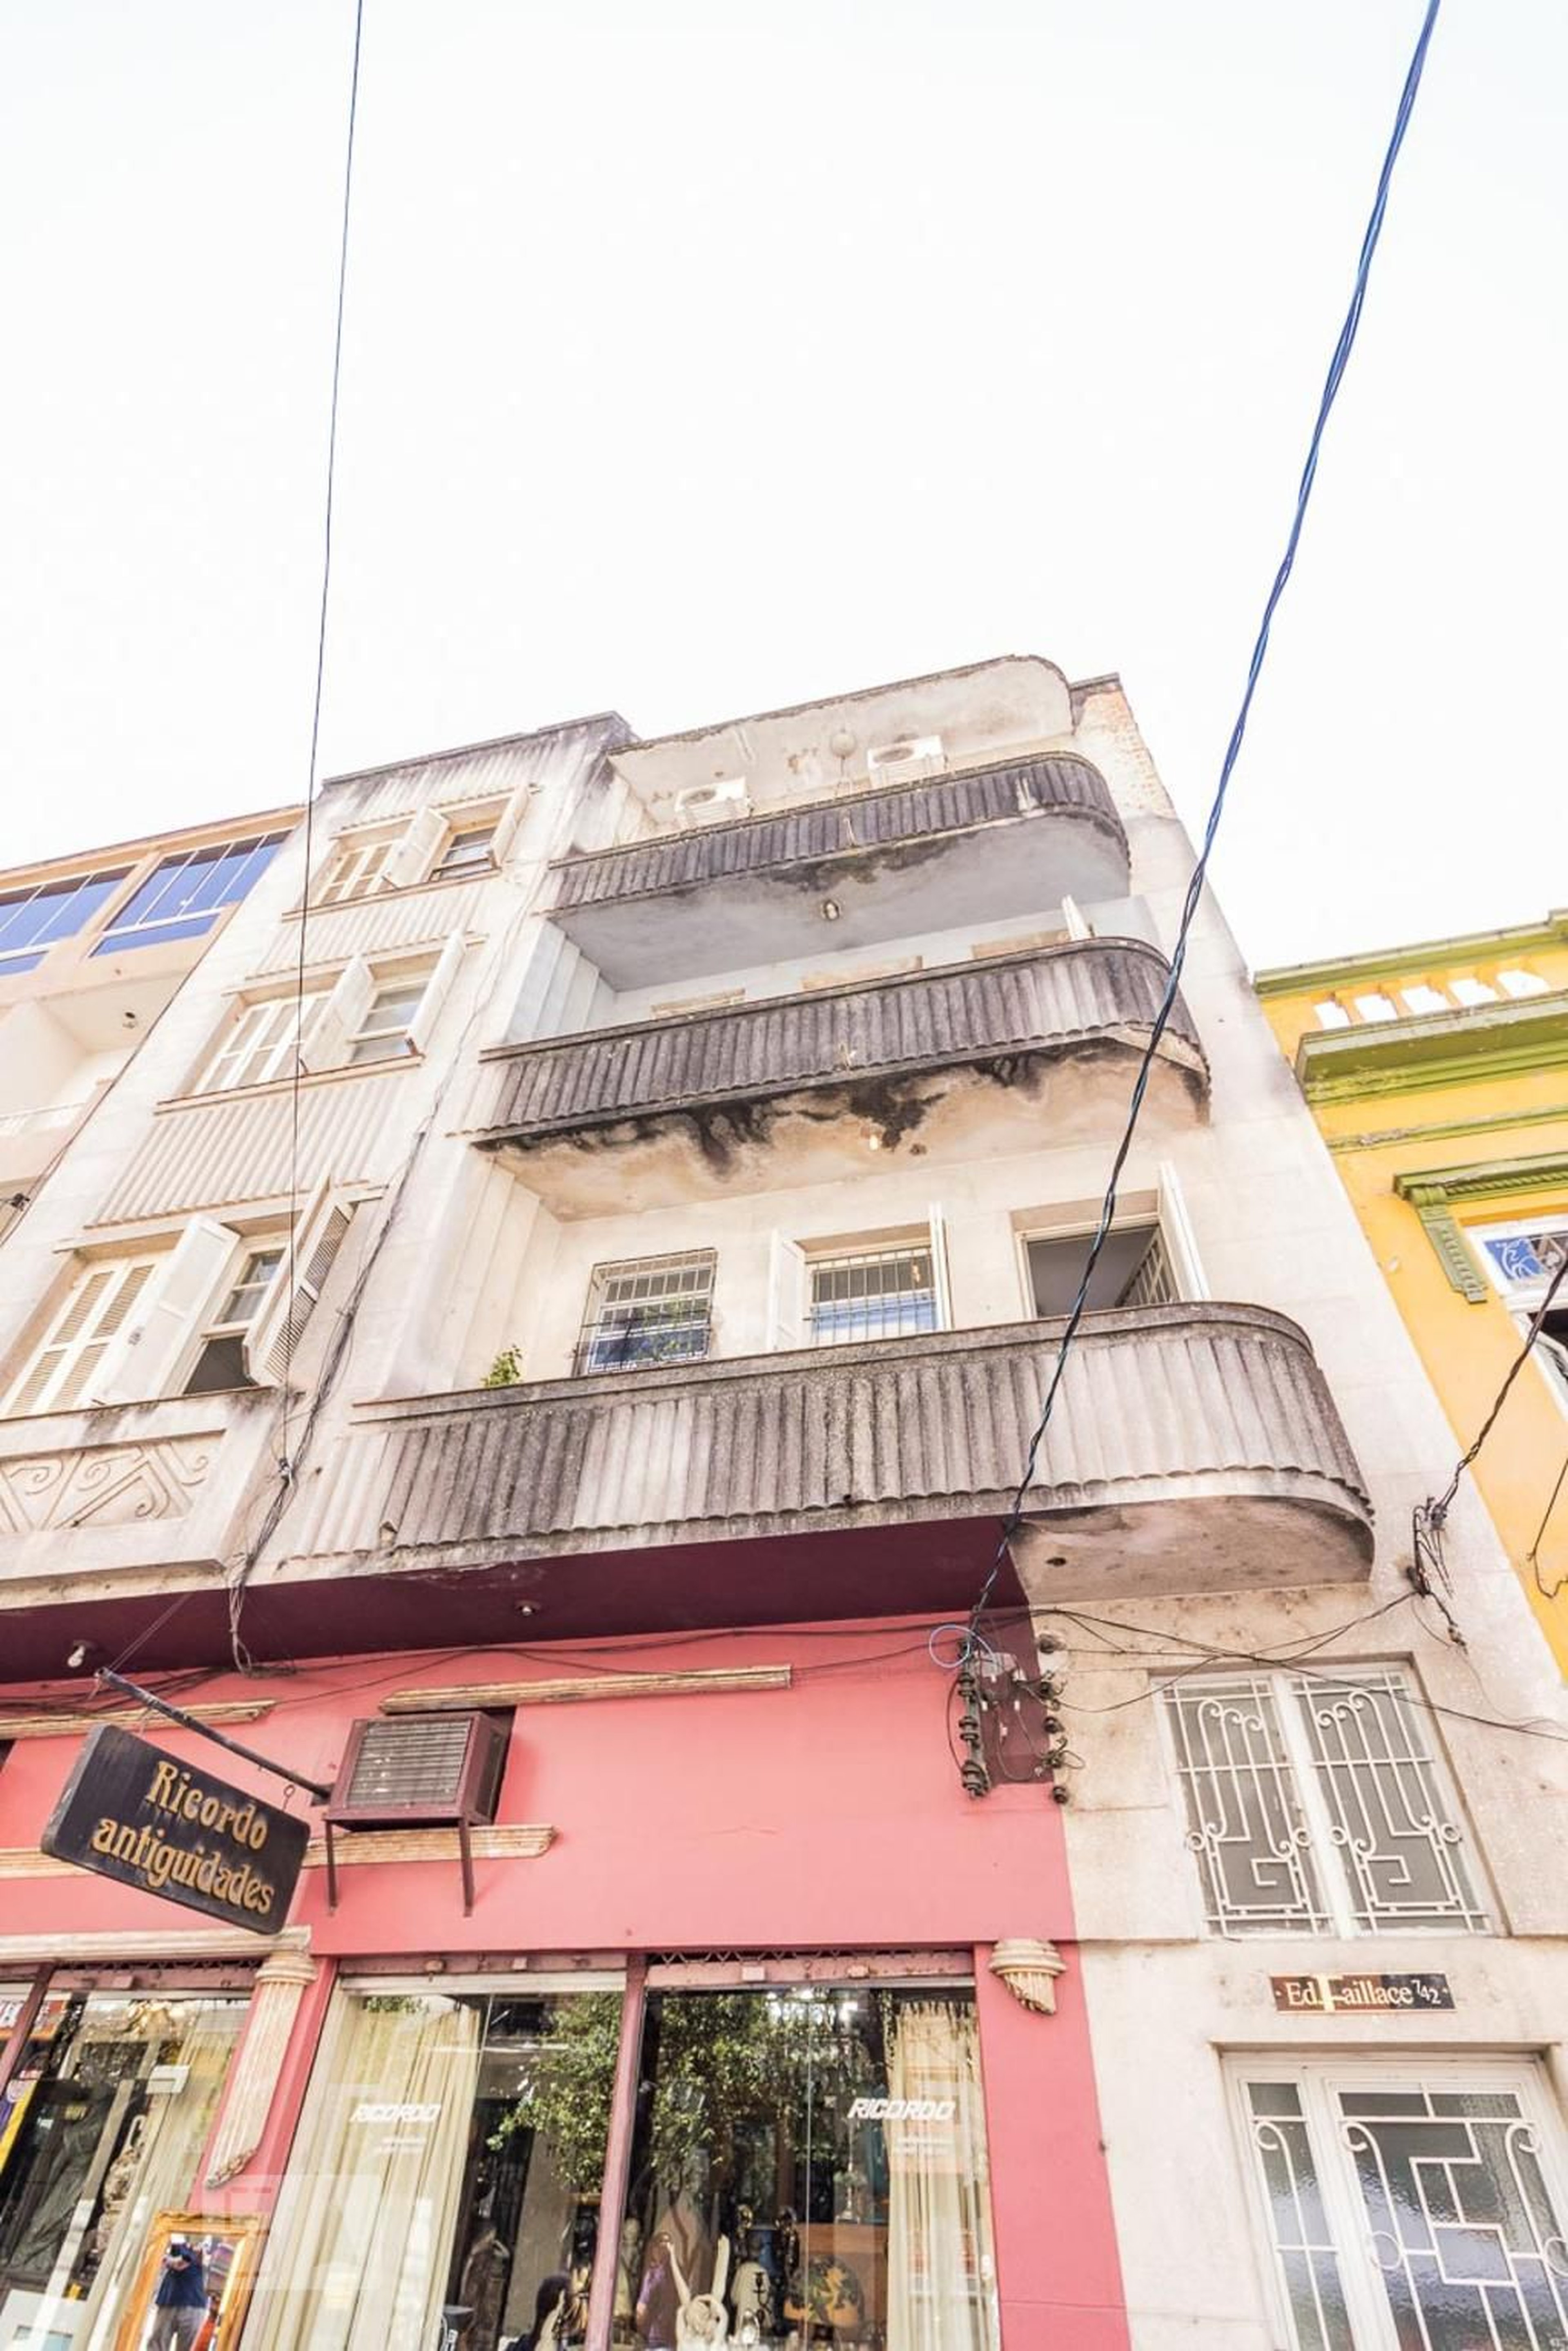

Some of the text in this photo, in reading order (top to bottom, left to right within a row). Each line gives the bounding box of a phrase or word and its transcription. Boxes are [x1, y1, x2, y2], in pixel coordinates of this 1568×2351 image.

[145, 1760, 268, 1849] Ricordo
[91, 1818, 274, 1914] antiguidades
[1411, 1980, 1442, 2005] 742
